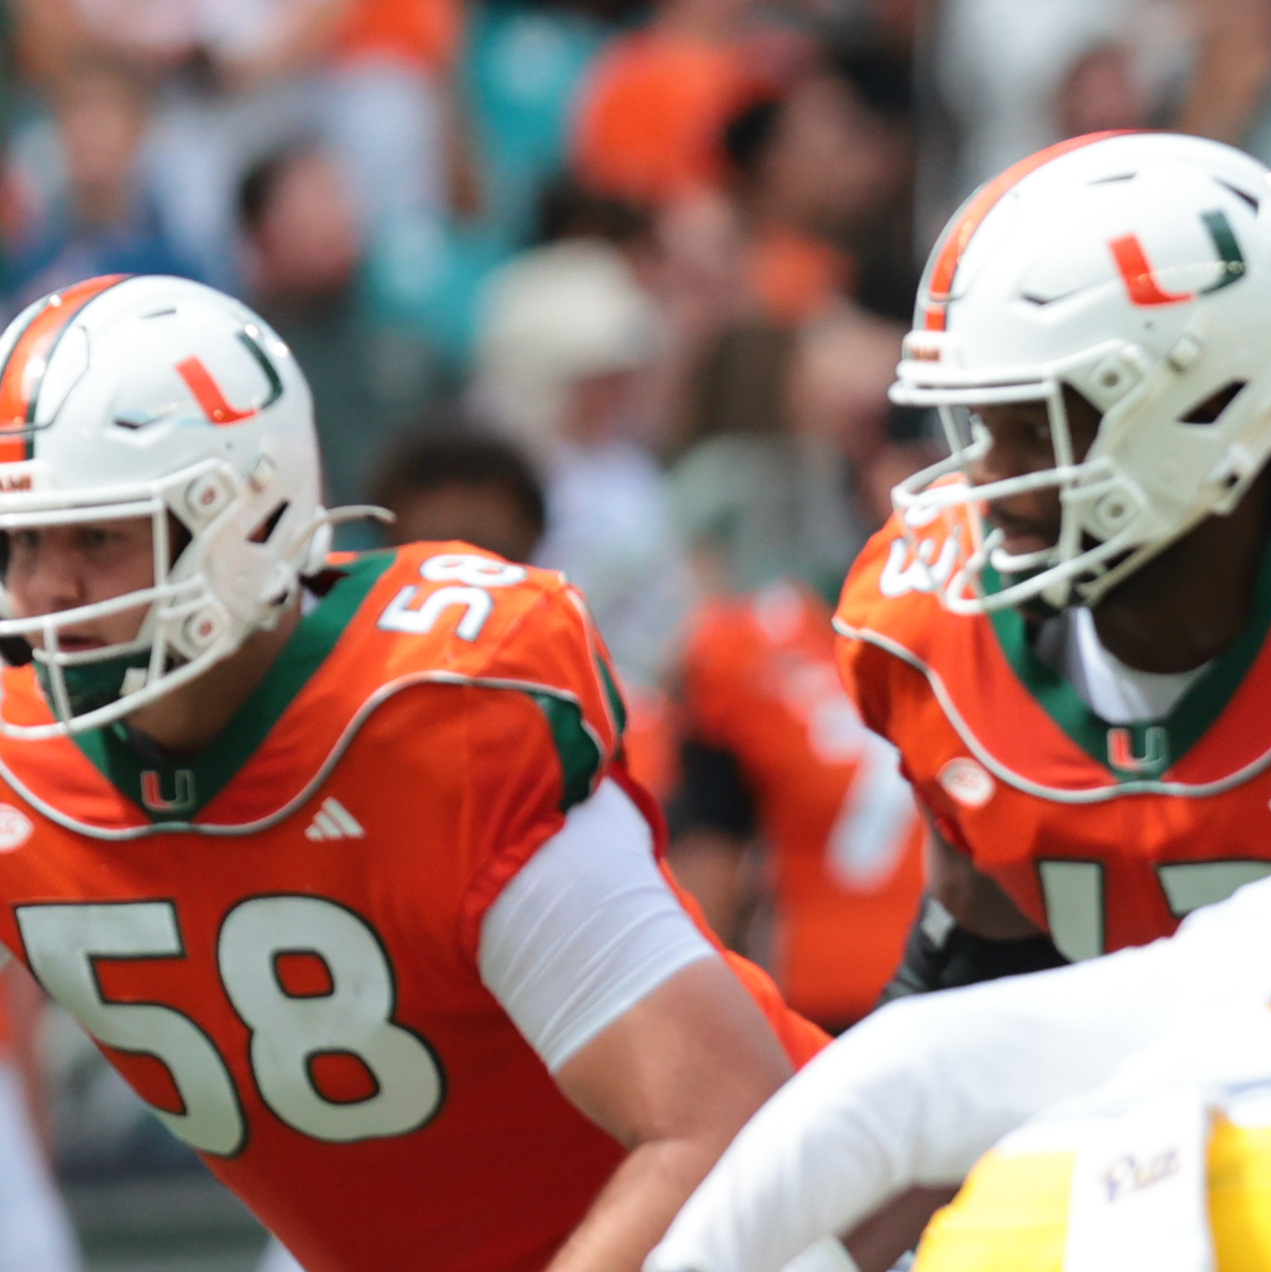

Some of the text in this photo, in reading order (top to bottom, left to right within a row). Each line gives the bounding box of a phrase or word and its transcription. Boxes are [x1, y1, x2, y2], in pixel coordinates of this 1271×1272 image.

[1108, 211, 1246, 307] U
[376, 553, 527, 642] 58
[14, 891, 447, 1159] 58
